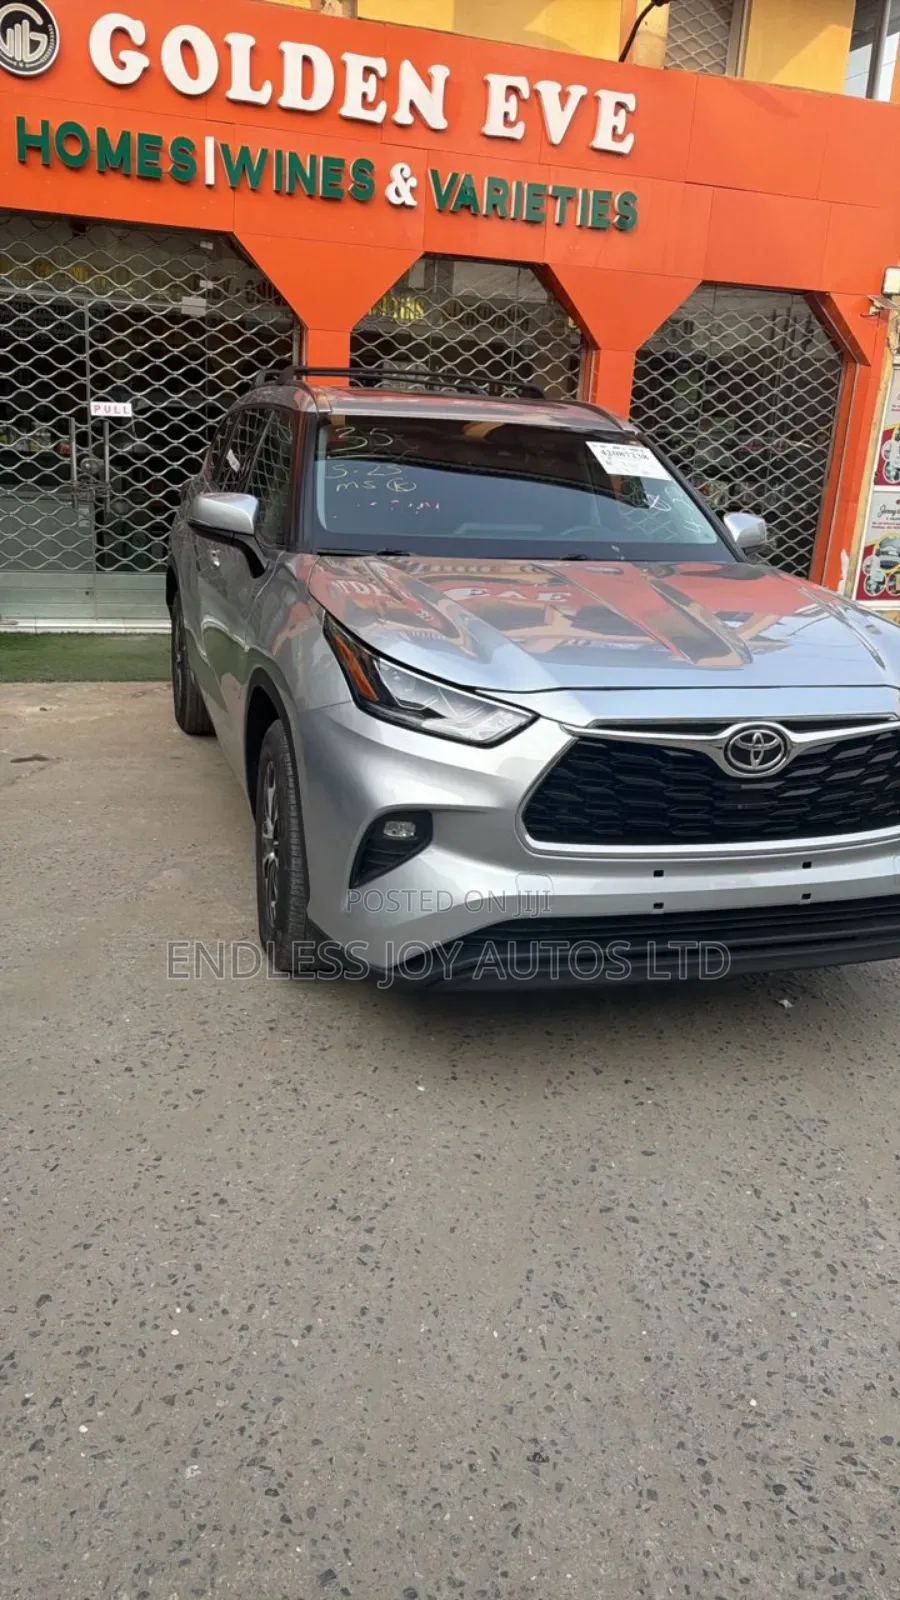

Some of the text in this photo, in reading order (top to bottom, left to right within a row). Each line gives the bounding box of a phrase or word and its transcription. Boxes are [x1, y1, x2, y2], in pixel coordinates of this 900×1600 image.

[89, 13, 450, 131] GOLDEN
[481, 73, 637, 155] EVE
[385, 162, 418, 208] &
[428, 168, 638, 231] VARIETIES
[93, 404, 130, 415] PULL
